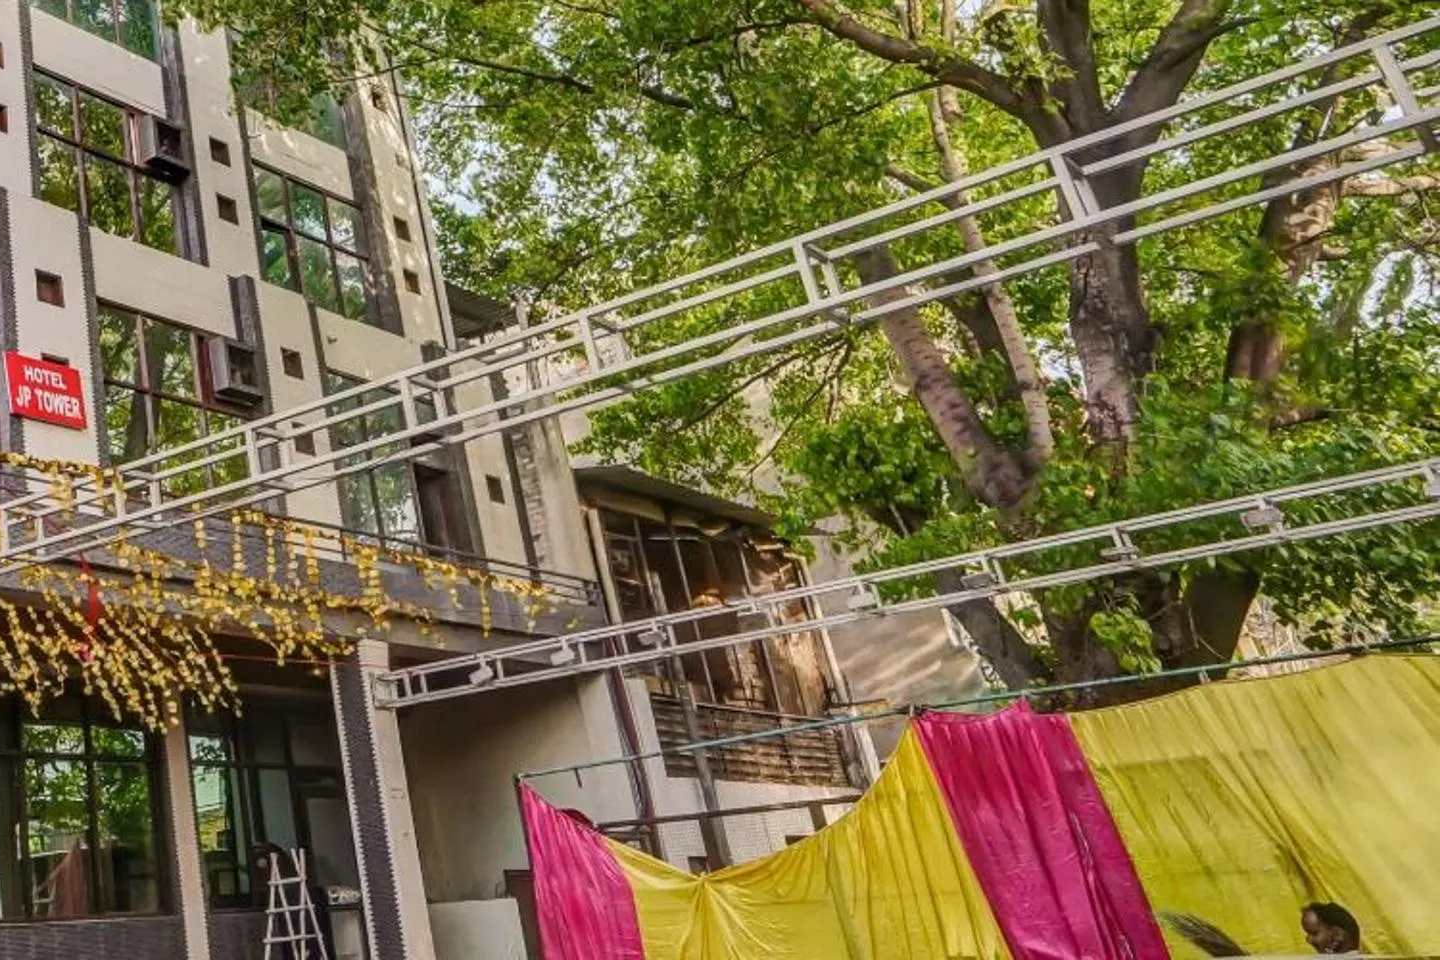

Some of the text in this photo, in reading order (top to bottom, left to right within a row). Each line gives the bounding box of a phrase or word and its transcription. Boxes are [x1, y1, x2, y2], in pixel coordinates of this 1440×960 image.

[23, 365, 67, 390] HOTEL
[16, 385, 83, 420] JP TOWER
